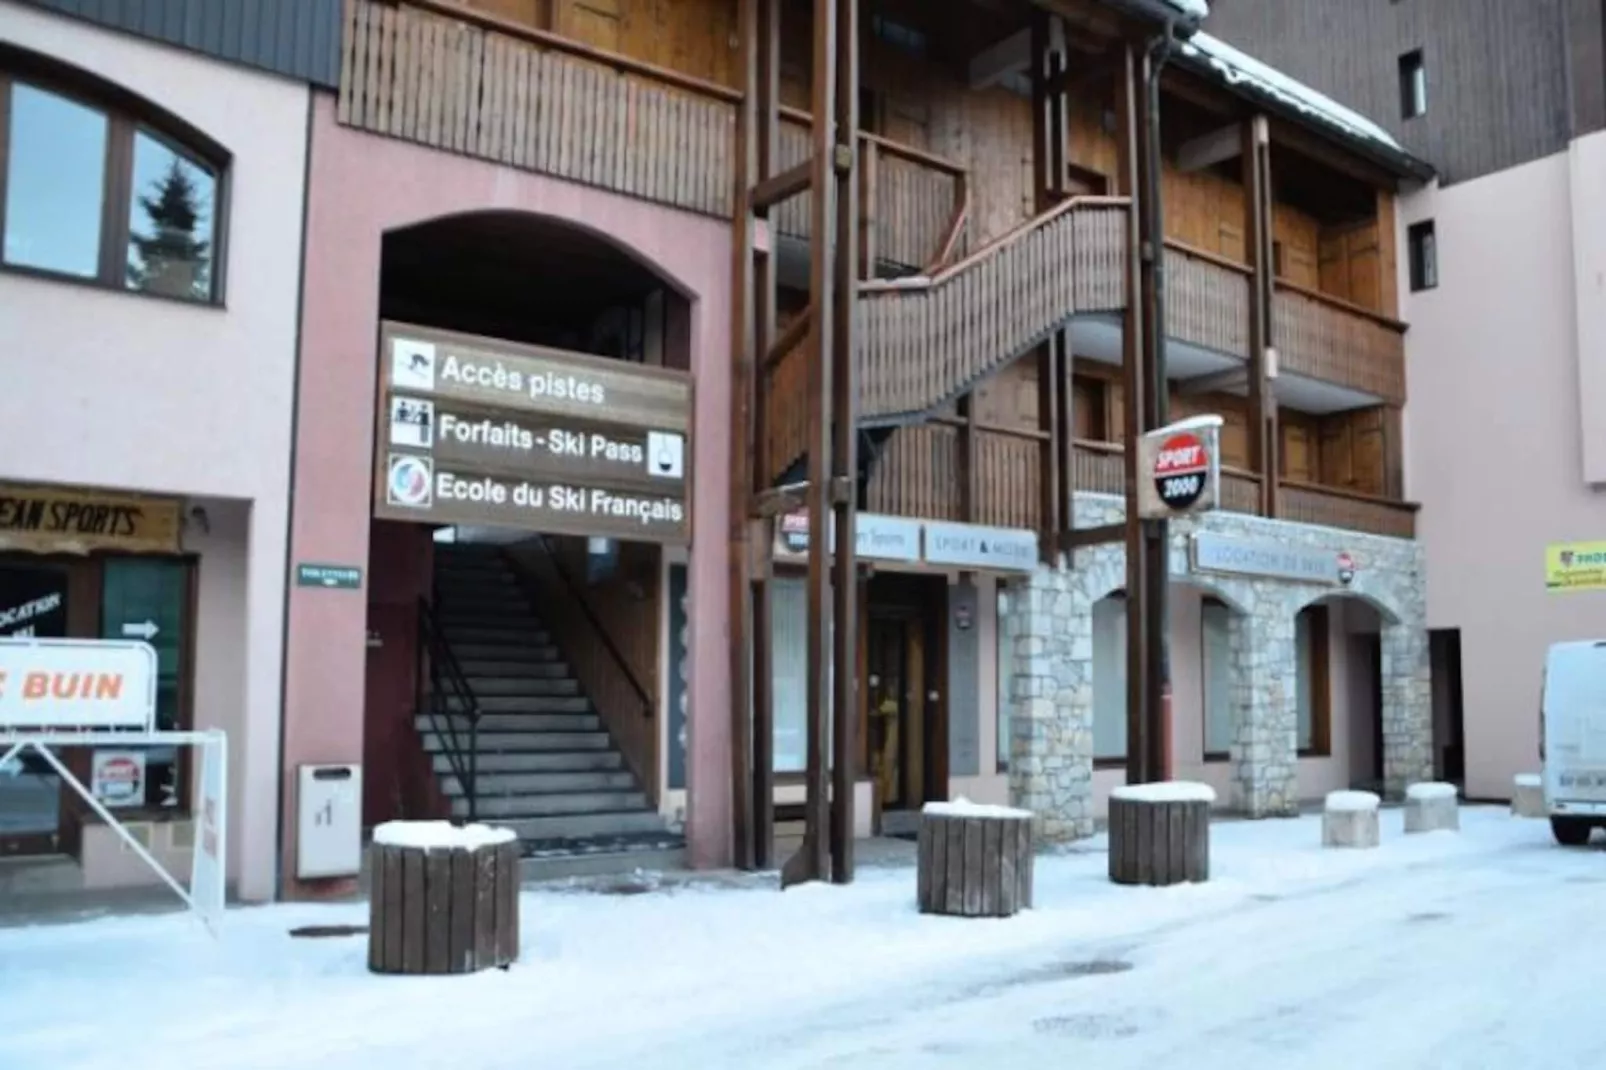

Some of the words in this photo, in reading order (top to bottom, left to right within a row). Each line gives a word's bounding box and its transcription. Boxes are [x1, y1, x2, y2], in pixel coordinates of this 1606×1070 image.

[440, 355, 523, 391] Accès
[529, 371, 605, 404] pistes
[438, 413, 534, 449] Forfaits
[548, 428, 586, 457] Ski
[590, 433, 644, 463] Pass
[1157, 445, 1202, 469] SPORT
[46, 500, 145, 536] SPORTS
[435, 472, 507, 504] Ecole
[512, 481, 544, 507] du
[548, 484, 586, 513] Ski
[590, 489, 683, 526] Français
[22, 670, 123, 701] BUIN
